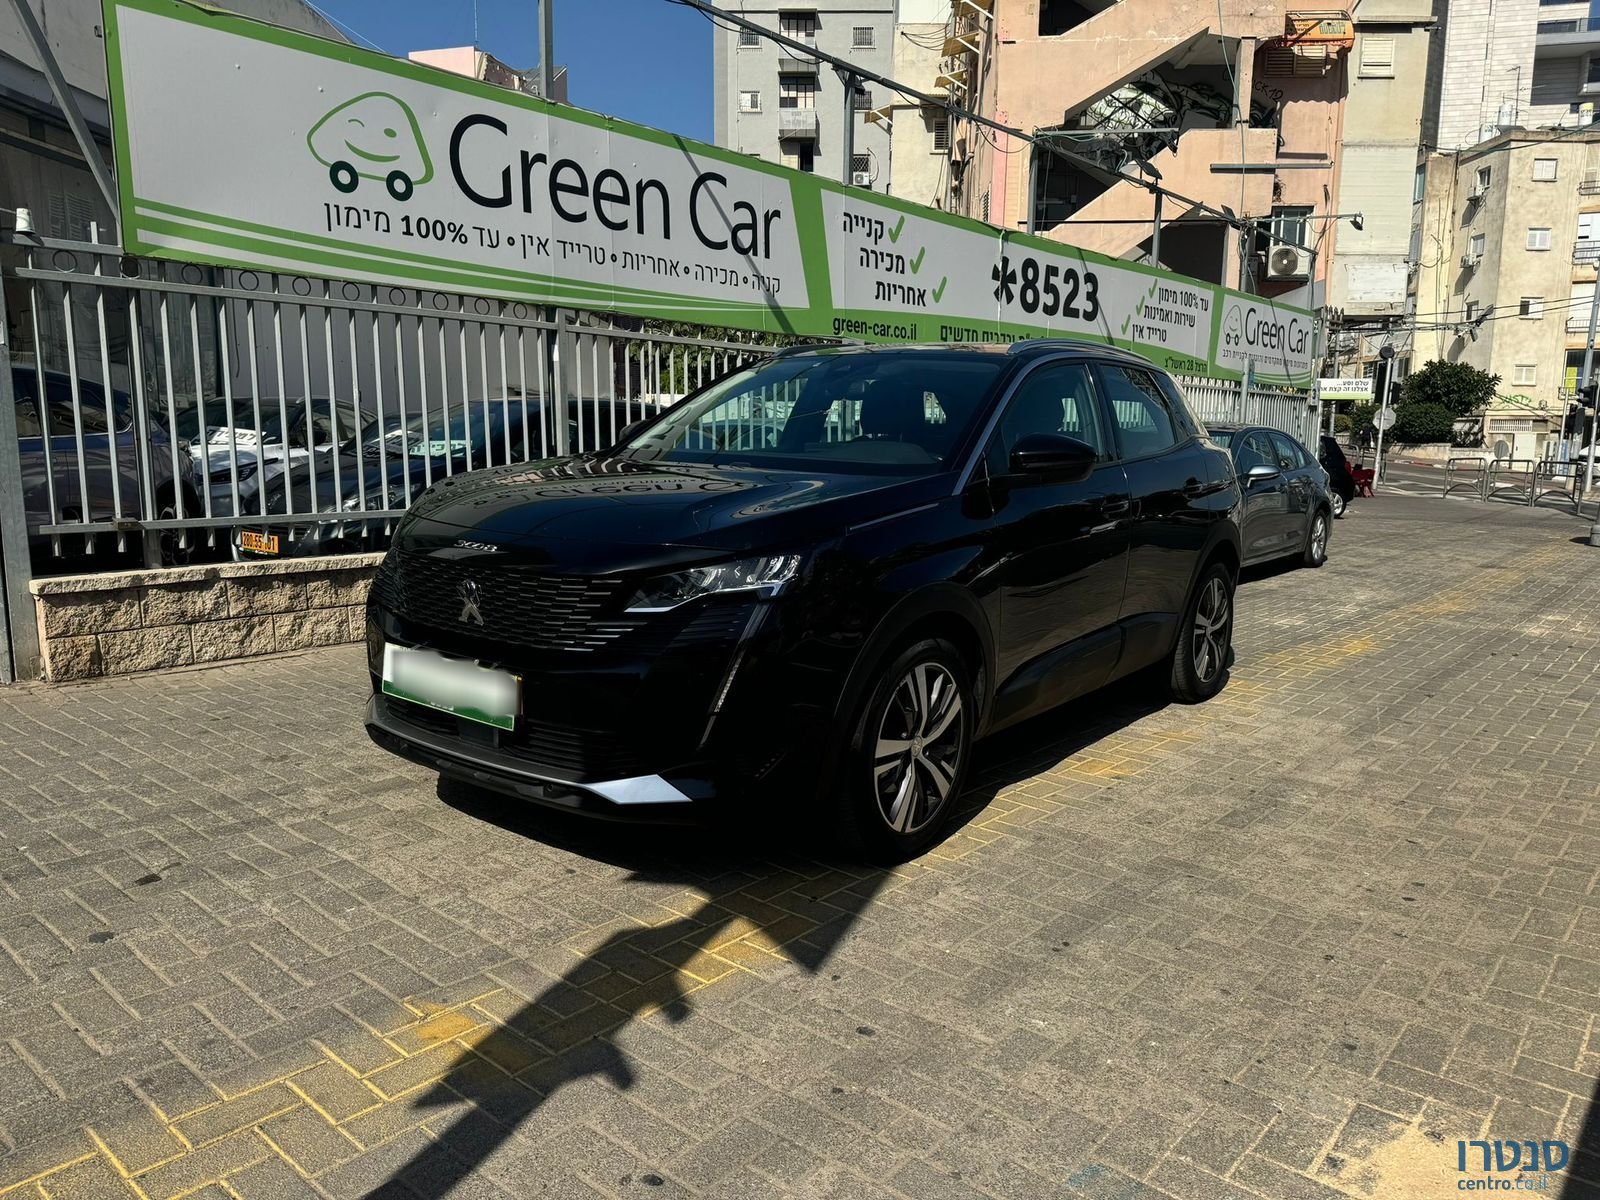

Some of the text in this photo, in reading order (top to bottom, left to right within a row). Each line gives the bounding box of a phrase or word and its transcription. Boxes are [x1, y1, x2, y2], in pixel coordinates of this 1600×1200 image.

[449, 113, 782, 260] Green Car
[842, 211, 885, 246] קנייה
[323, 202, 782, 299] קניה מכירה אחריות טרייד אין עד 100% מימון
[859, 246, 906, 275] מכירה
[874, 280, 927, 308] אחריות
[1158, 287, 1209, 312] עד 100% מימון
[832, 317, 917, 340] green-car.co.il
[1143, 305, 1196, 328] שירות ואמינות
[940, 325, 979, 343] חדשים
[1132, 324, 1167, 343] טרייד אין
[1244, 307, 1309, 355] Green Car
